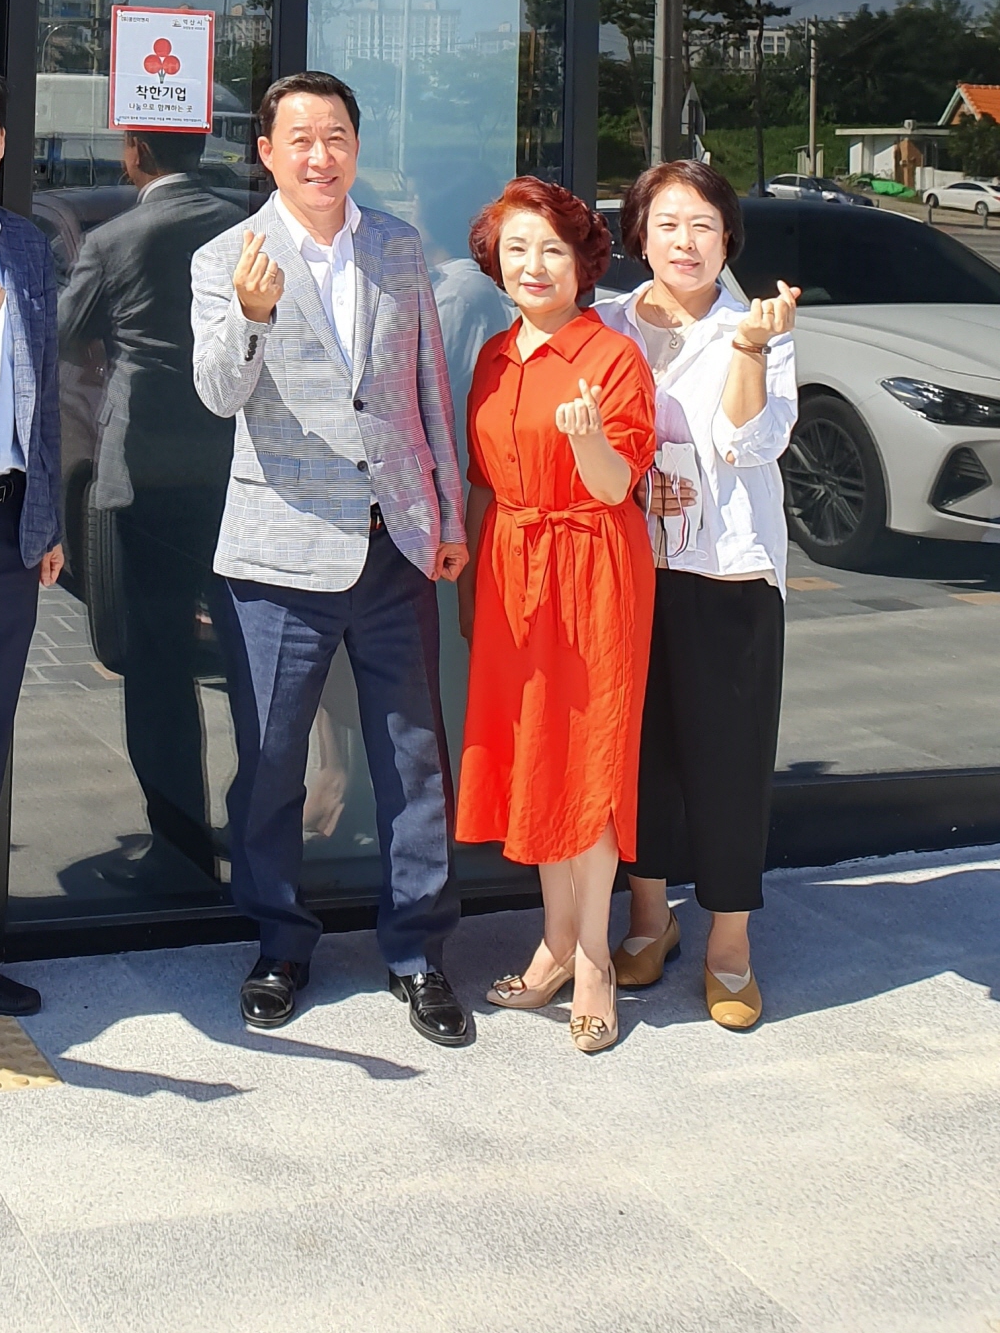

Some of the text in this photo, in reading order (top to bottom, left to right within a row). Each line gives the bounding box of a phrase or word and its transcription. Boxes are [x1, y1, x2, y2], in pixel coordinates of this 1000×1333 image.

[136, 85, 186, 101] 착한기업
[129, 103, 193, 113] 나눔으로 함께하는 곳
